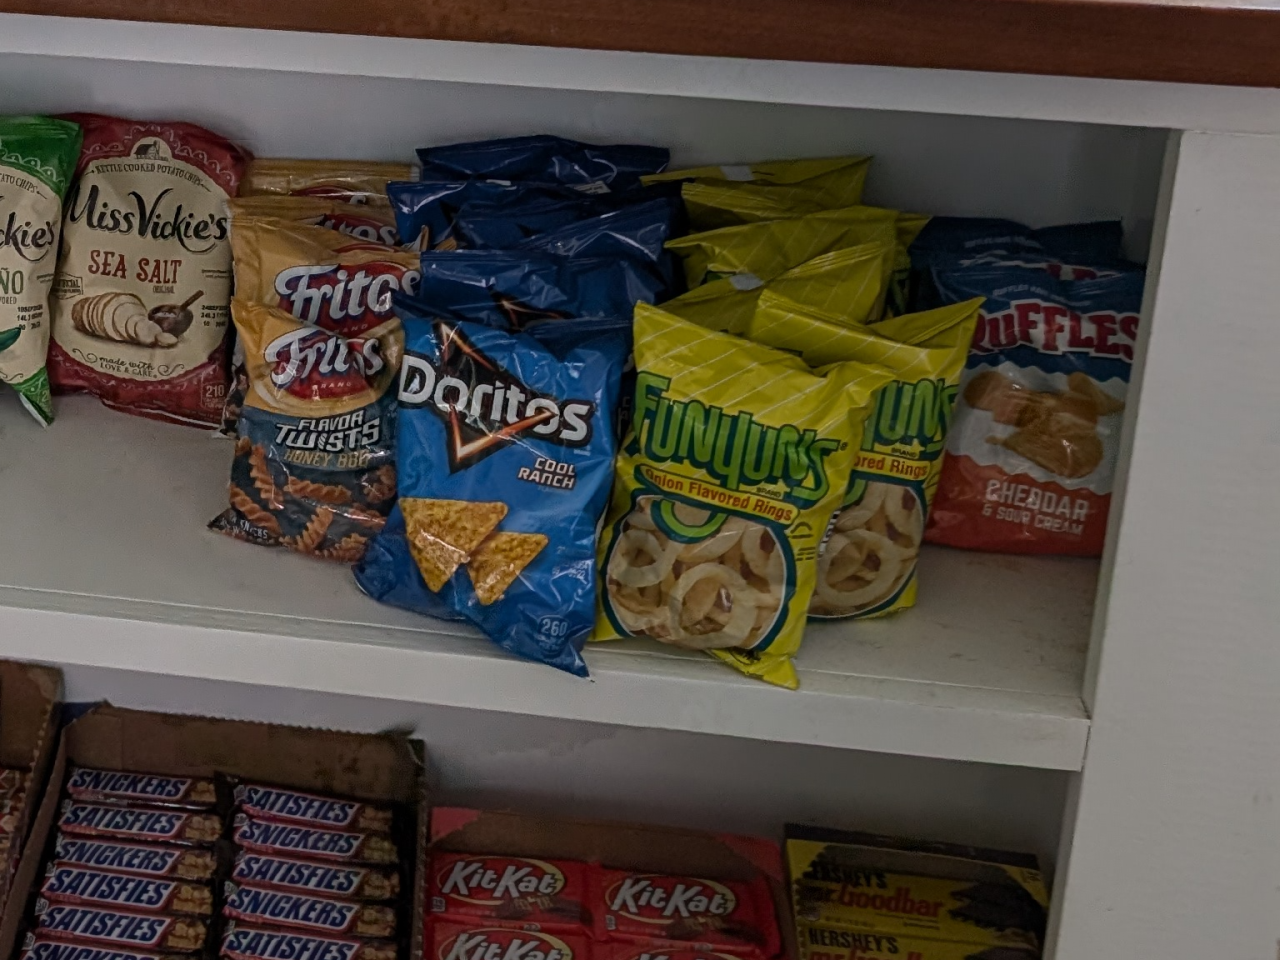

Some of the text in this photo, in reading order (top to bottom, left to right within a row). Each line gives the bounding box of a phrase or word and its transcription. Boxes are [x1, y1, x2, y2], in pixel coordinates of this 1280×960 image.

[15, 177, 38, 193] CHIPS
[95, 162, 202, 186] KETTLE COOKED POTATO CHIPS
[128, 188, 228, 254] Vickie's
[88, 250, 182, 285] SEA SALT
[99, 356, 155, 371] made with
[100, 362, 122, 373] LOVE
[205, 385, 224, 398] 210
[400, 355, 591, 443] Doritos
[275, 419, 380, 452] TWISTS
[297, 409, 364, 431] FLAVOR
[634, 372, 840, 502] FUNYUNS
[284, 448, 333, 468] HONEY
[534, 457, 576, 476] COOL
[889, 459, 928, 479] Rings
[518, 467, 576, 489] RANCH
[645, 468, 793, 523] Onion Flavored Rings
[985, 479, 1090, 522] CHEDDAR
[995, 506, 1084, 536] SOUR CREAM
[540, 619, 568, 636] 260
[72, 769, 190, 799] SNICKERS
[64, 802, 184, 836] SATISFIES
[244, 785, 357, 825] SATISFIES
[240, 820, 362, 858] SNICKERS
[58, 840, 178, 873] SNICKERS
[49, 869, 171, 908] SATISFIES
[237, 855, 365, 894] SATISFIES
[40, 907, 166, 942] SATISFIES
[230, 888, 356, 930] SNICKERS
[808, 927, 899, 954] HERSHEY'S
